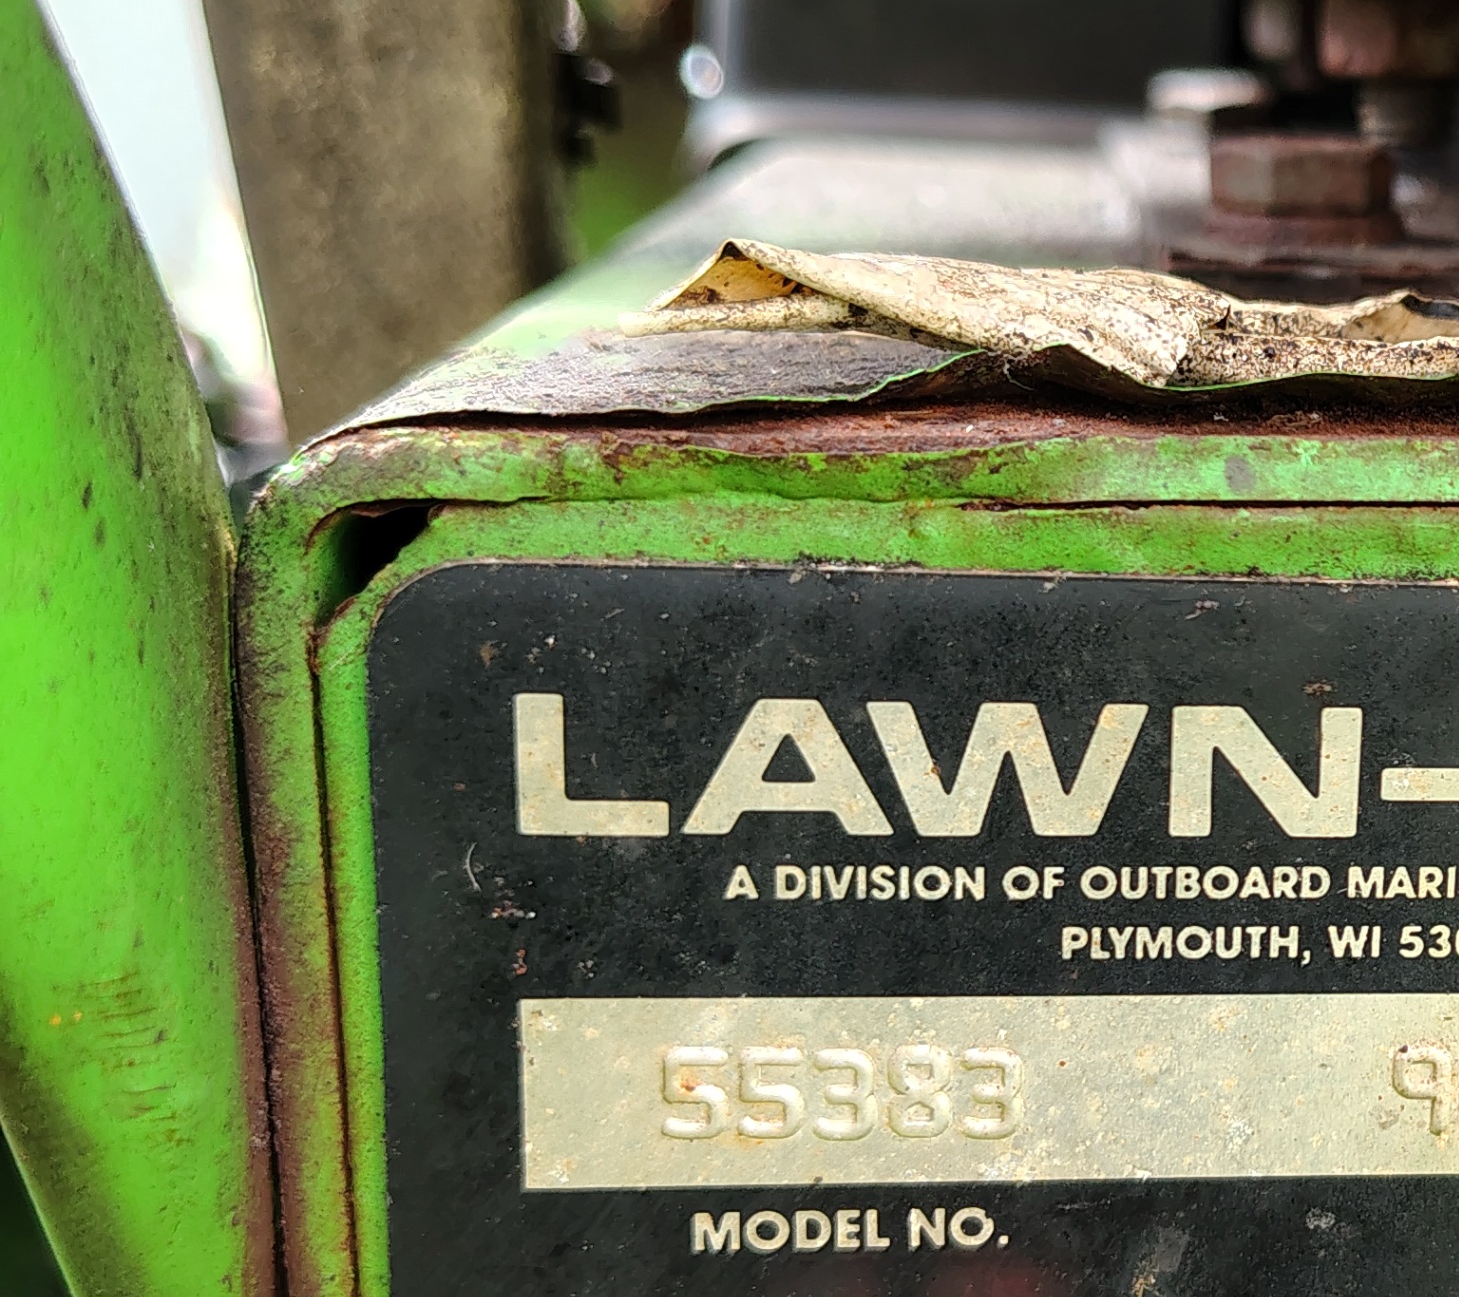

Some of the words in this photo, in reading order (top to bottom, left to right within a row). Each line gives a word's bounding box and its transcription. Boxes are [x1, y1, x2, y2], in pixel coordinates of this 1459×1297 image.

[723, 864, 759, 900] A
[774, 865, 986, 901] DIVISION
[1001, 865, 1065, 901] OF
[1080, 865, 1331, 900] OUTBOARD
[1061, 925, 1311, 966] PLYMOUTH,
[1327, 924, 1381, 959] WI
[660, 1044, 1026, 1141] 55383
[691, 1208, 891, 1254] MODEL
[907, 1206, 1010, 1250] NO.
